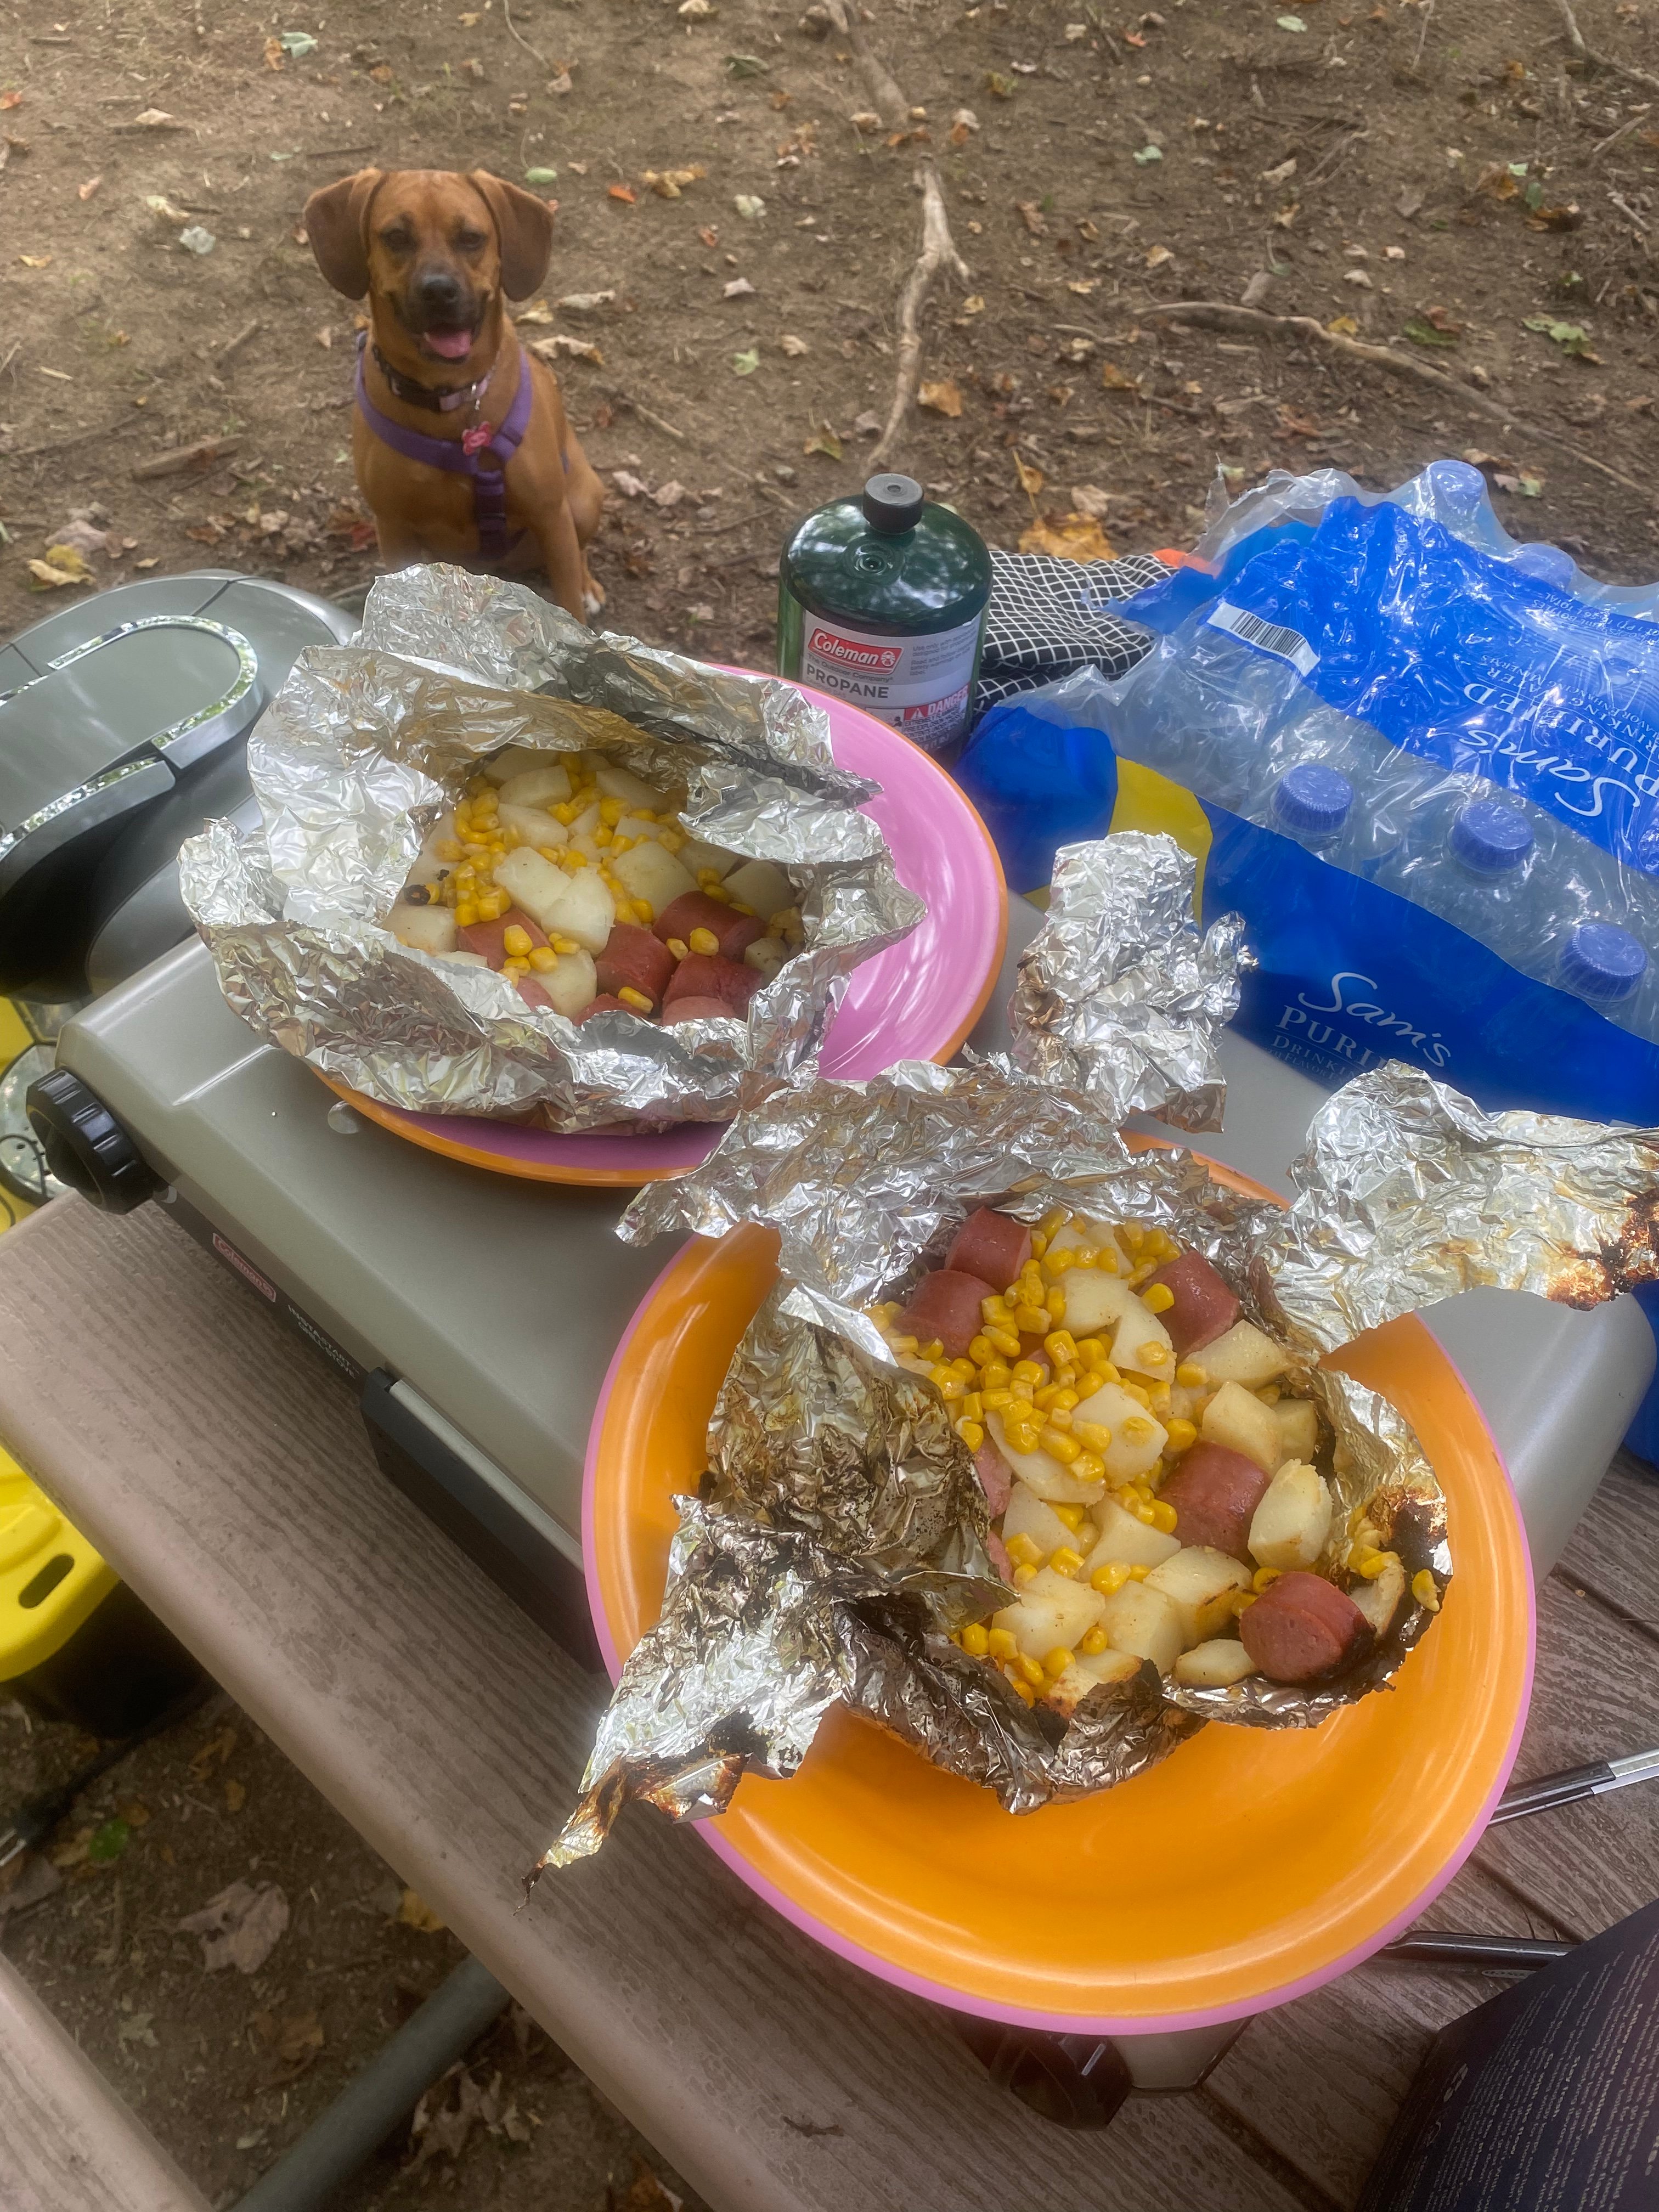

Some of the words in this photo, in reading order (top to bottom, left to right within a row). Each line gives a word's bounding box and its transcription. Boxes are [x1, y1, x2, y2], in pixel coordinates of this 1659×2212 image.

[1545, 592, 1573, 612] TOTAL
[814, 632, 879, 666] Coleman
[808, 653, 821, 665] The
[822, 661, 850, 676] Outdoor
[807, 663, 889, 699] PROPANE
[928, 685, 968, 715] DANGER
[1568, 697, 1659, 760] RINKING
[1459, 729, 1640, 817] Sam's
[1297, 972, 1451, 1067] Sam's
[1276, 1005, 1388, 1069] PURI
[218, 1239, 264, 1289] Coleman
[1623, 2004, 1642, 2042] Follow
[1544, 2053, 1553, 2068] Go
[1566, 2056, 1580, 2081] Stay
[1610, 2047, 1623, 2074] your
[1498, 2075, 1512, 2100] kind
[1531, 2073, 1544, 2098] with
[1522, 2103, 1532, 2122] the
[1587, 2080, 1612, 2137] instincts.
[1483, 2119, 1493, 2138] the
